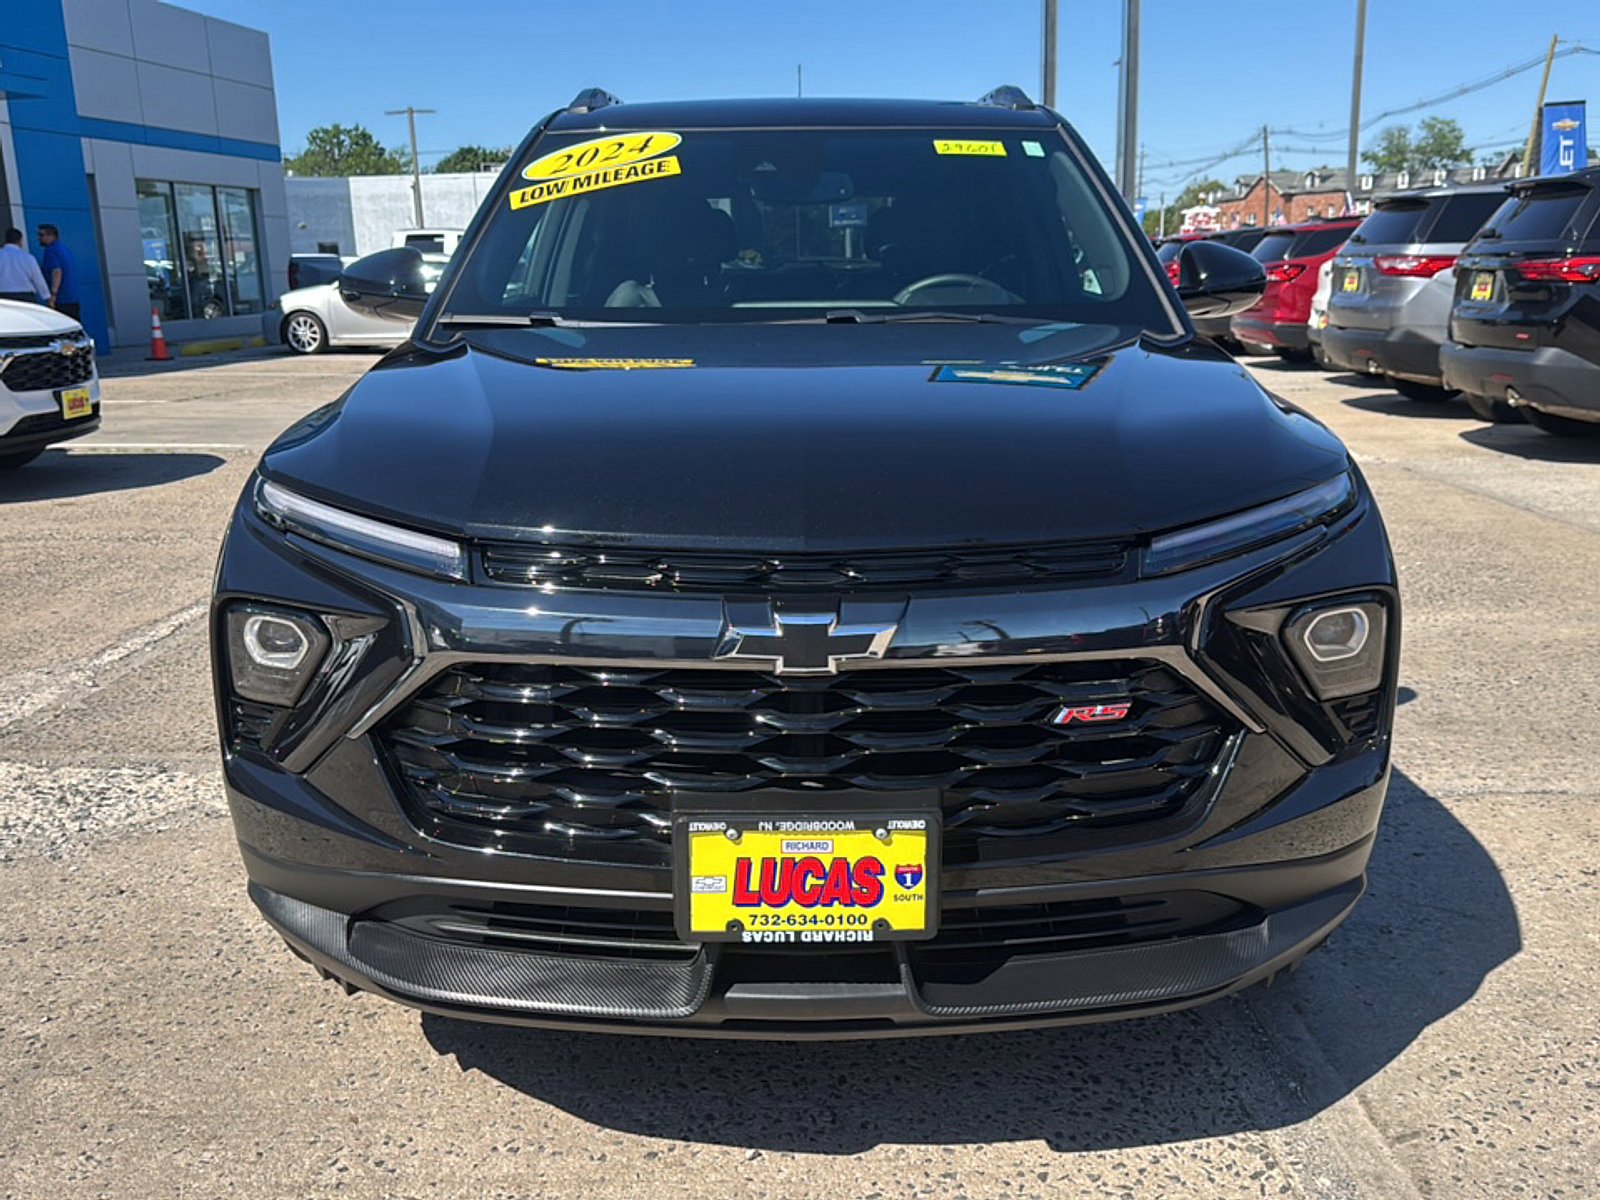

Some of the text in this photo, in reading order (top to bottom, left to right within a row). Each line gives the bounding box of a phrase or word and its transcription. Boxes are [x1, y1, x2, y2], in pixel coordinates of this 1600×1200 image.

[549, 135, 654, 175] 2024
[520, 160, 671, 204] LOW MILEAGE
[1053, 703, 1131, 724] RS
[758, 821, 855, 831] WOODBRIDGE, NJ
[785, 842, 830, 851] RICHARD
[732, 856, 886, 908] LUCAS
[903, 873, 914, 886] 1
[893, 894, 924, 902] SOUTH
[748, 914, 868, 926] 732-634-0100
[742, 930, 873, 943] RICHARD LUCAS
